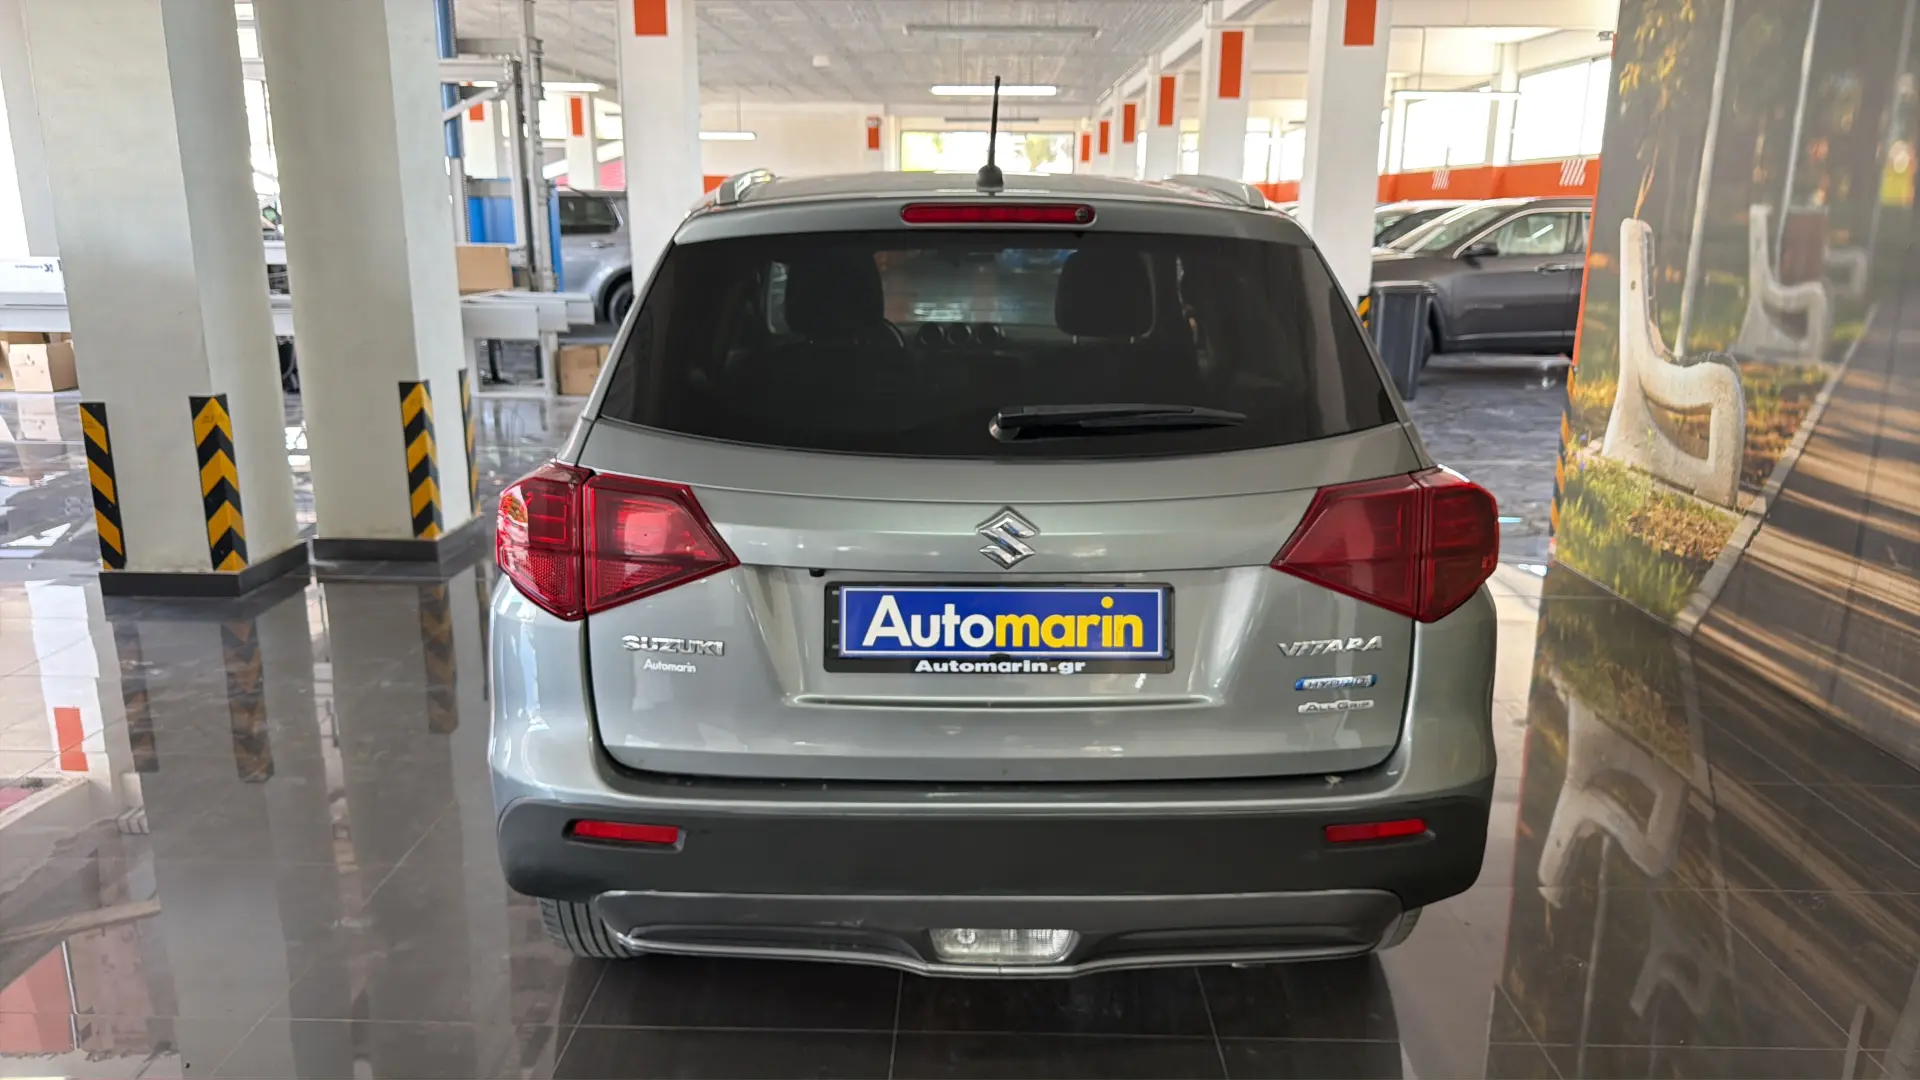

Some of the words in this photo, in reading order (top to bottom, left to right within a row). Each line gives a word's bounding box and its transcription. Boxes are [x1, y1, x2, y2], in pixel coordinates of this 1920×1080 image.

[861, 595, 1144, 648] Automarin
[621, 634, 726, 656] SUZUKI
[1277, 635, 1383, 657] VITARA
[643, 658, 697, 673] Automarin
[914, 659, 1086, 673] Automarin.gr
